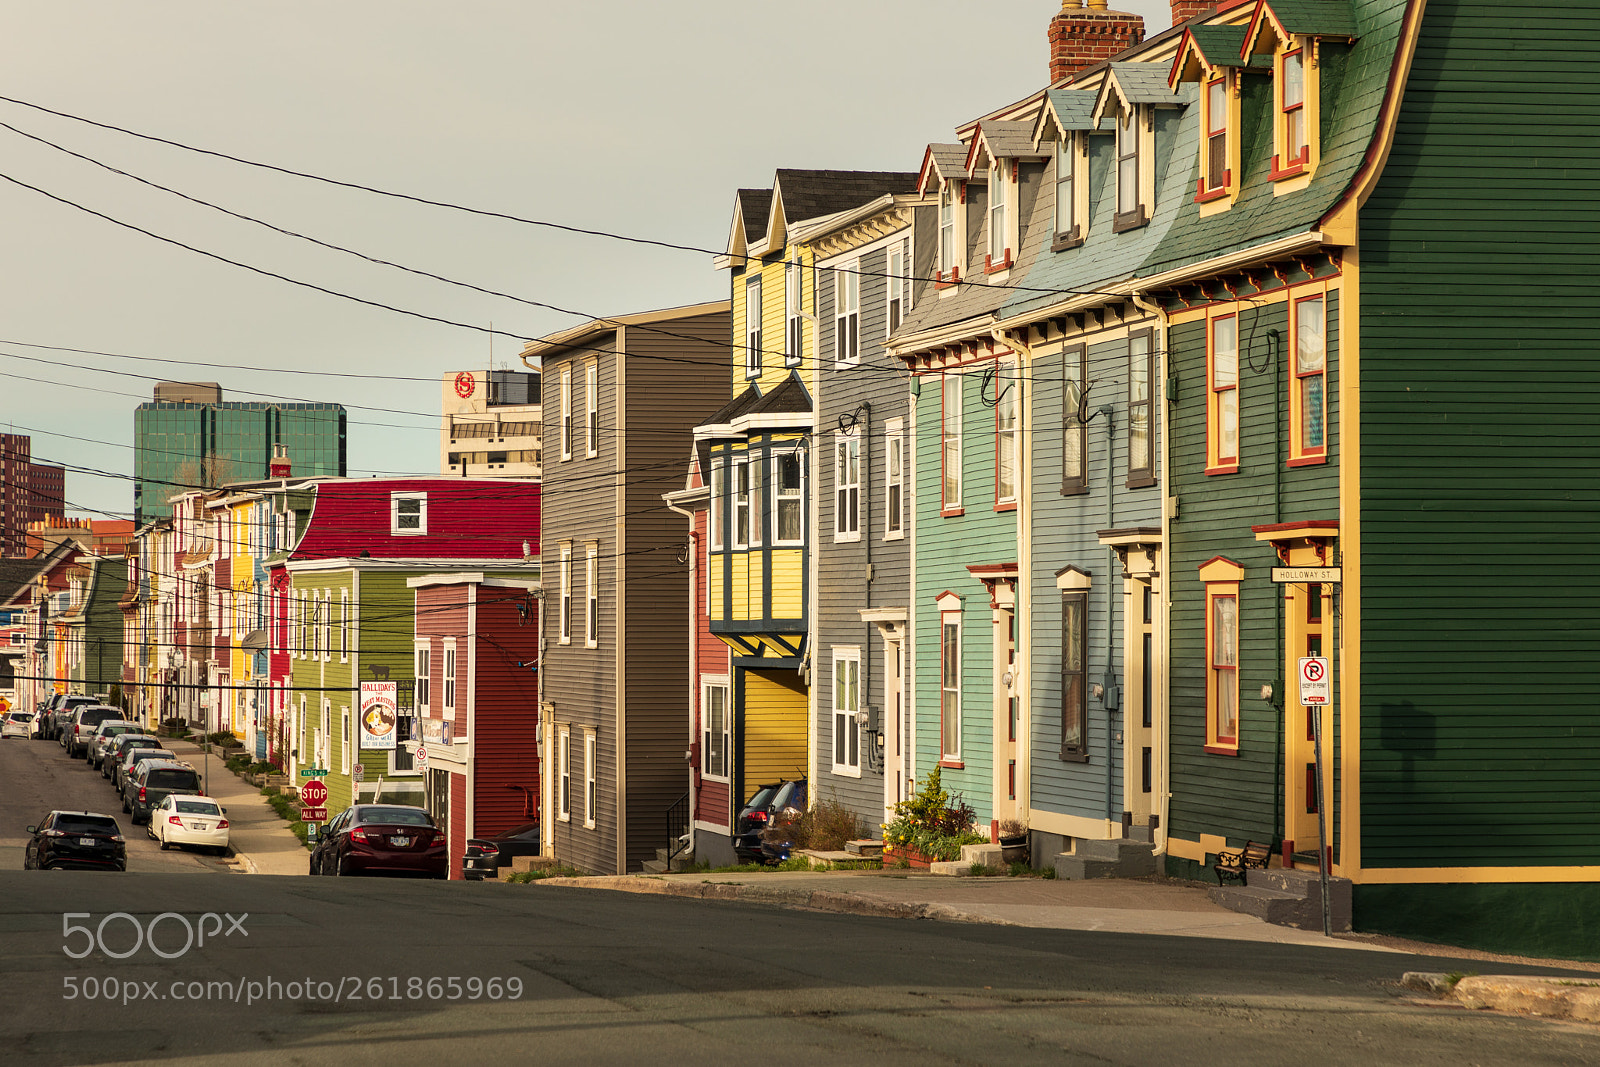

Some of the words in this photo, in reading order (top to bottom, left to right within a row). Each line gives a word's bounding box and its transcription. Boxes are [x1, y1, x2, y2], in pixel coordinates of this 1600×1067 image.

[460, 377, 470, 392] S
[362, 697, 374, 711] MEAT
[376, 697, 395, 710] MASTERS
[302, 788, 327, 799] STOP
[302, 811, 313, 819] ALL
